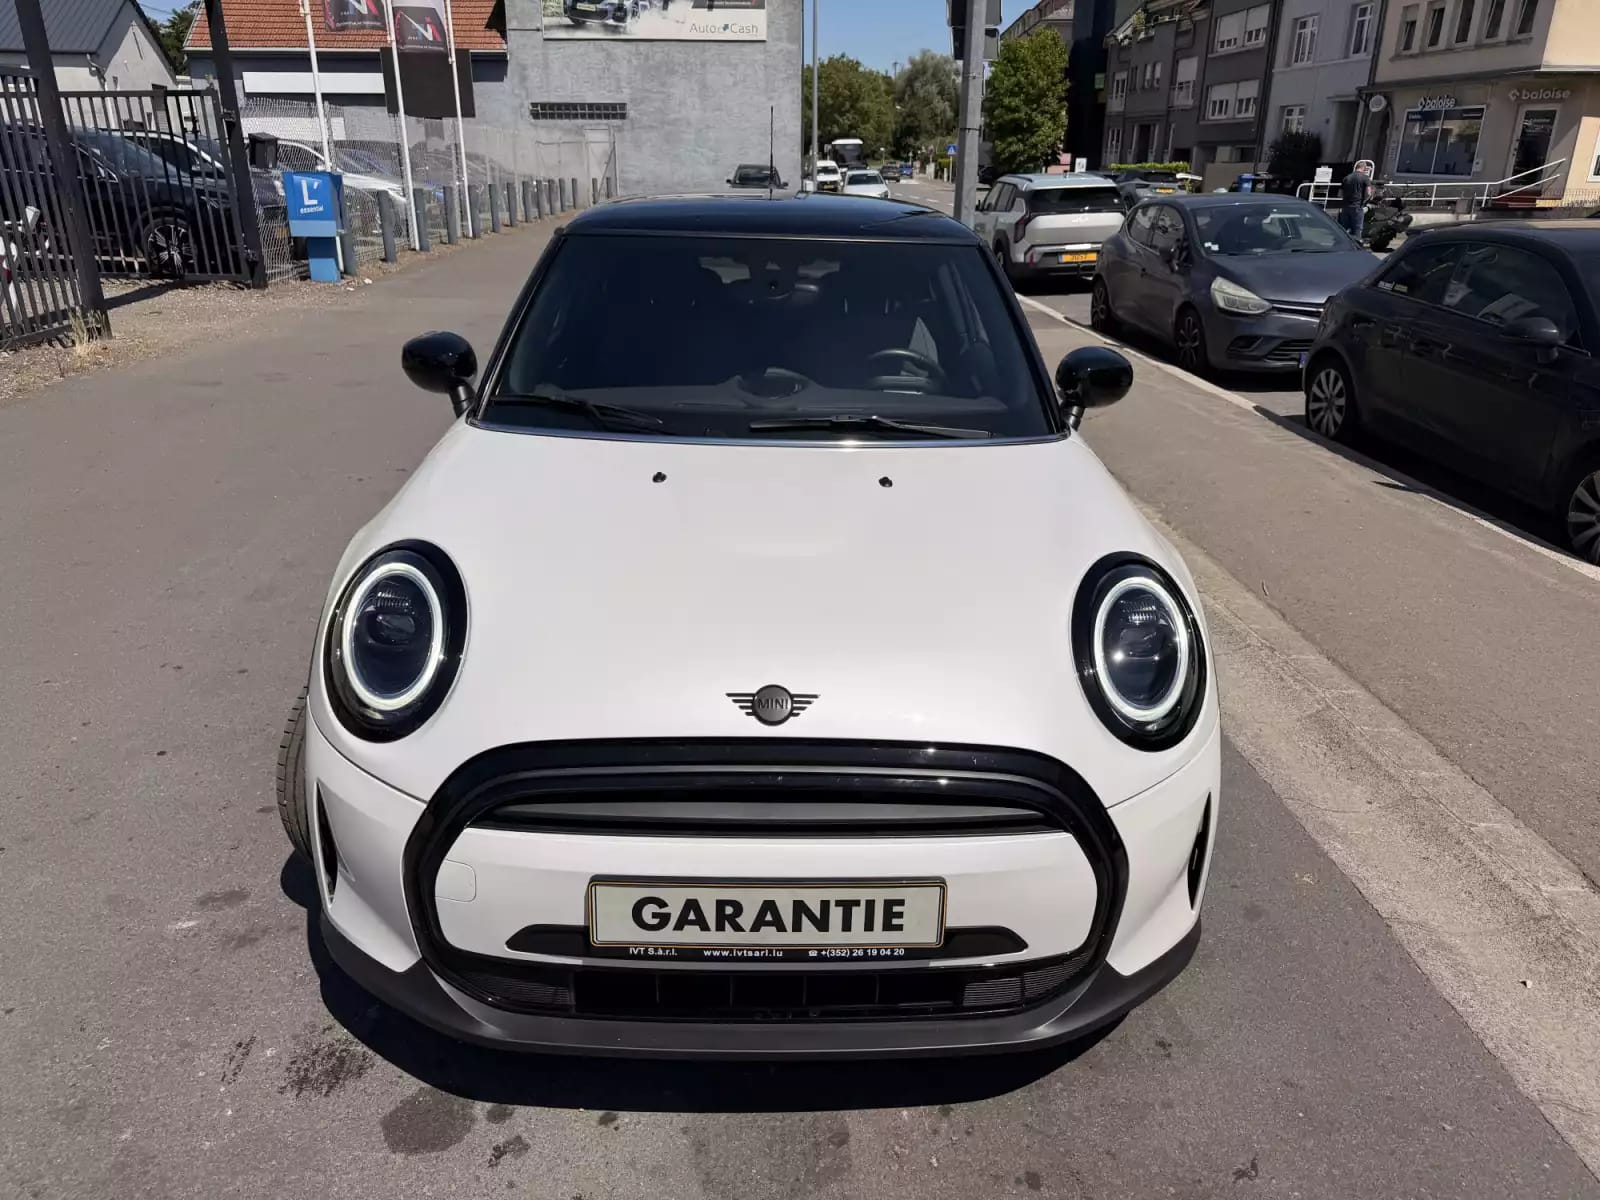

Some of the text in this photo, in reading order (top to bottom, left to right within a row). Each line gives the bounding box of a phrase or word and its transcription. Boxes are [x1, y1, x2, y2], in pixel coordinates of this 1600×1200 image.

[730, 23, 758, 34] Cash
[1521, 87, 1571, 100] baloise
[1424, 95, 1456, 111] baloise
[758, 698, 789, 709] MINI
[631, 896, 905, 933] GARANTIE
[629, 947, 645, 955] IVT
[820, 948, 905, 958] +(352) 26 19 04 20
